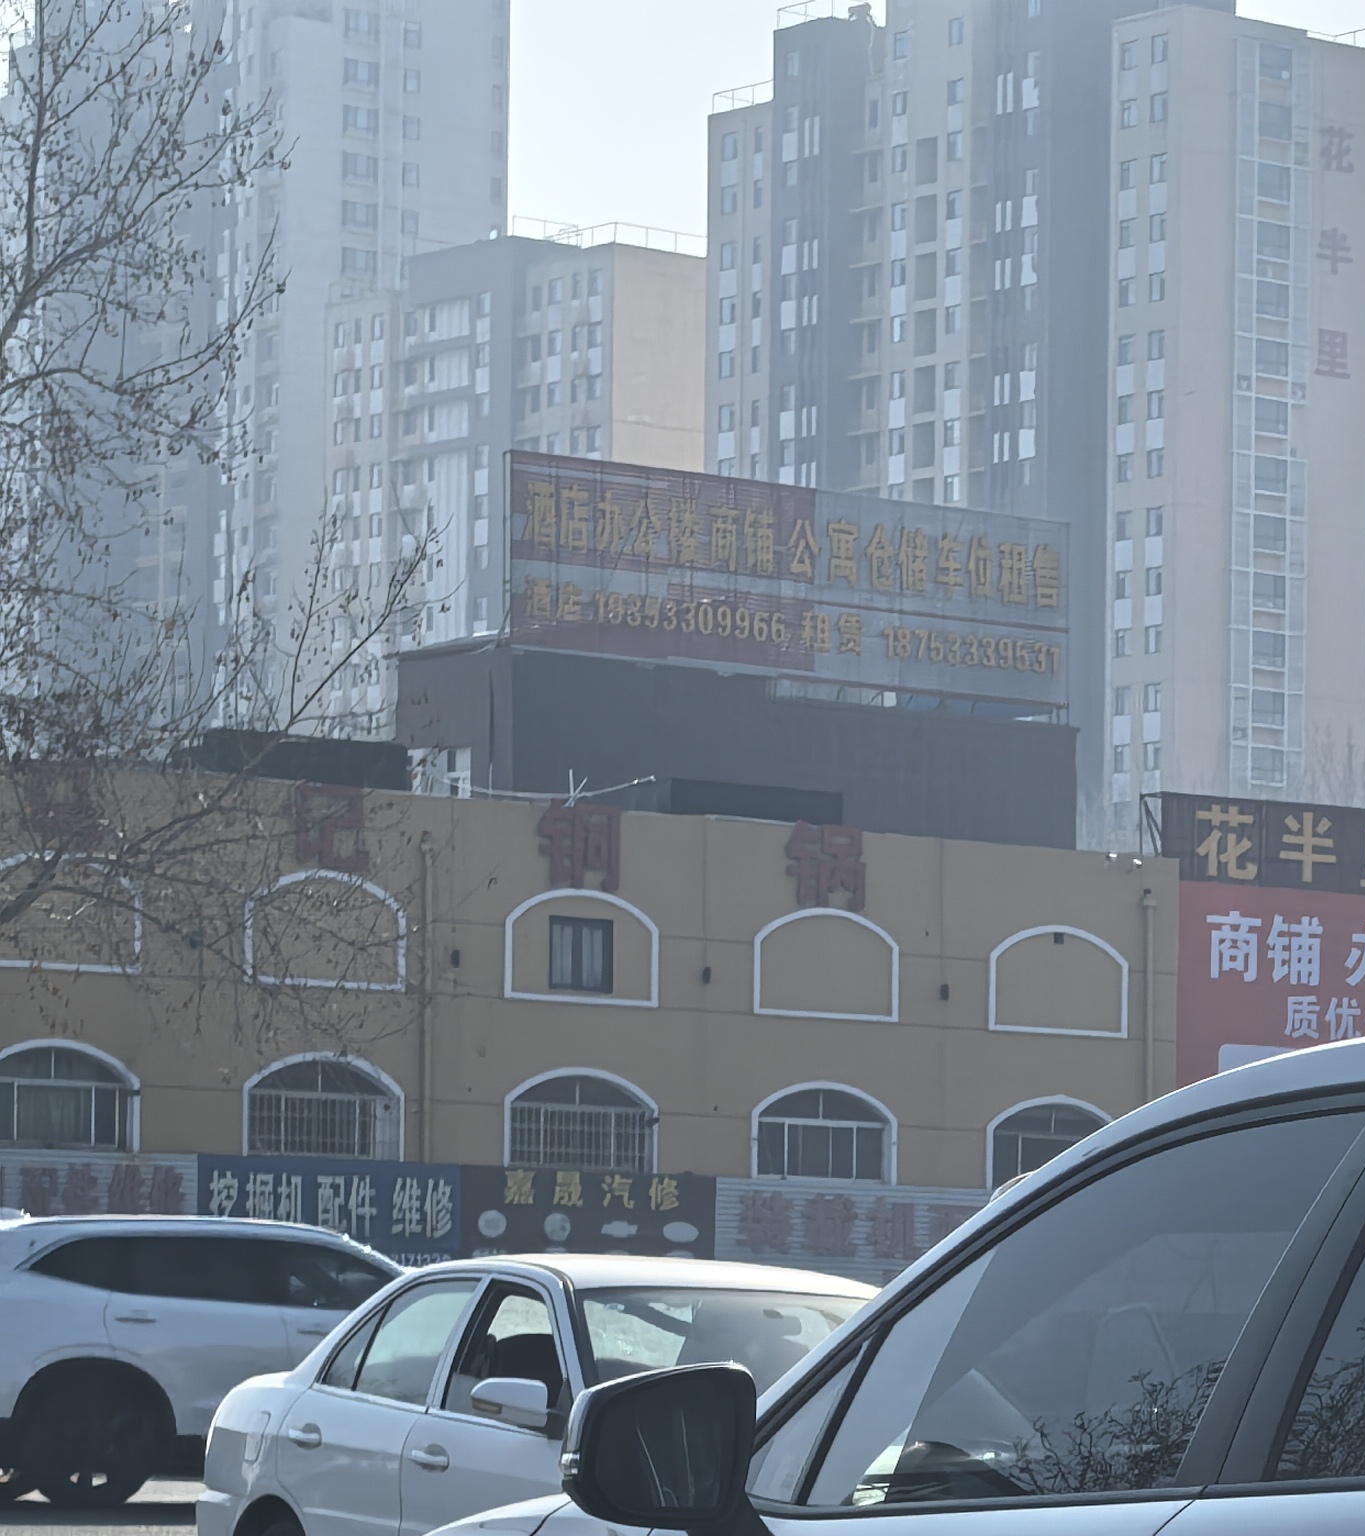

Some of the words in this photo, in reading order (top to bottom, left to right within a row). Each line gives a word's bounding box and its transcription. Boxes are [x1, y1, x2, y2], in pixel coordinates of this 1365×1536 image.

[1314, 125, 1354, 379] 花半里
[524, 575, 583, 621] 酒店
[802, 611, 861, 656] 租赁
[1206, 911, 1323, 986] 商铺
[208, 1168, 303, 1221] 挖掘机
[317, 1173, 377, 1237] 配件
[391, 1176, 454, 1240] 维修
